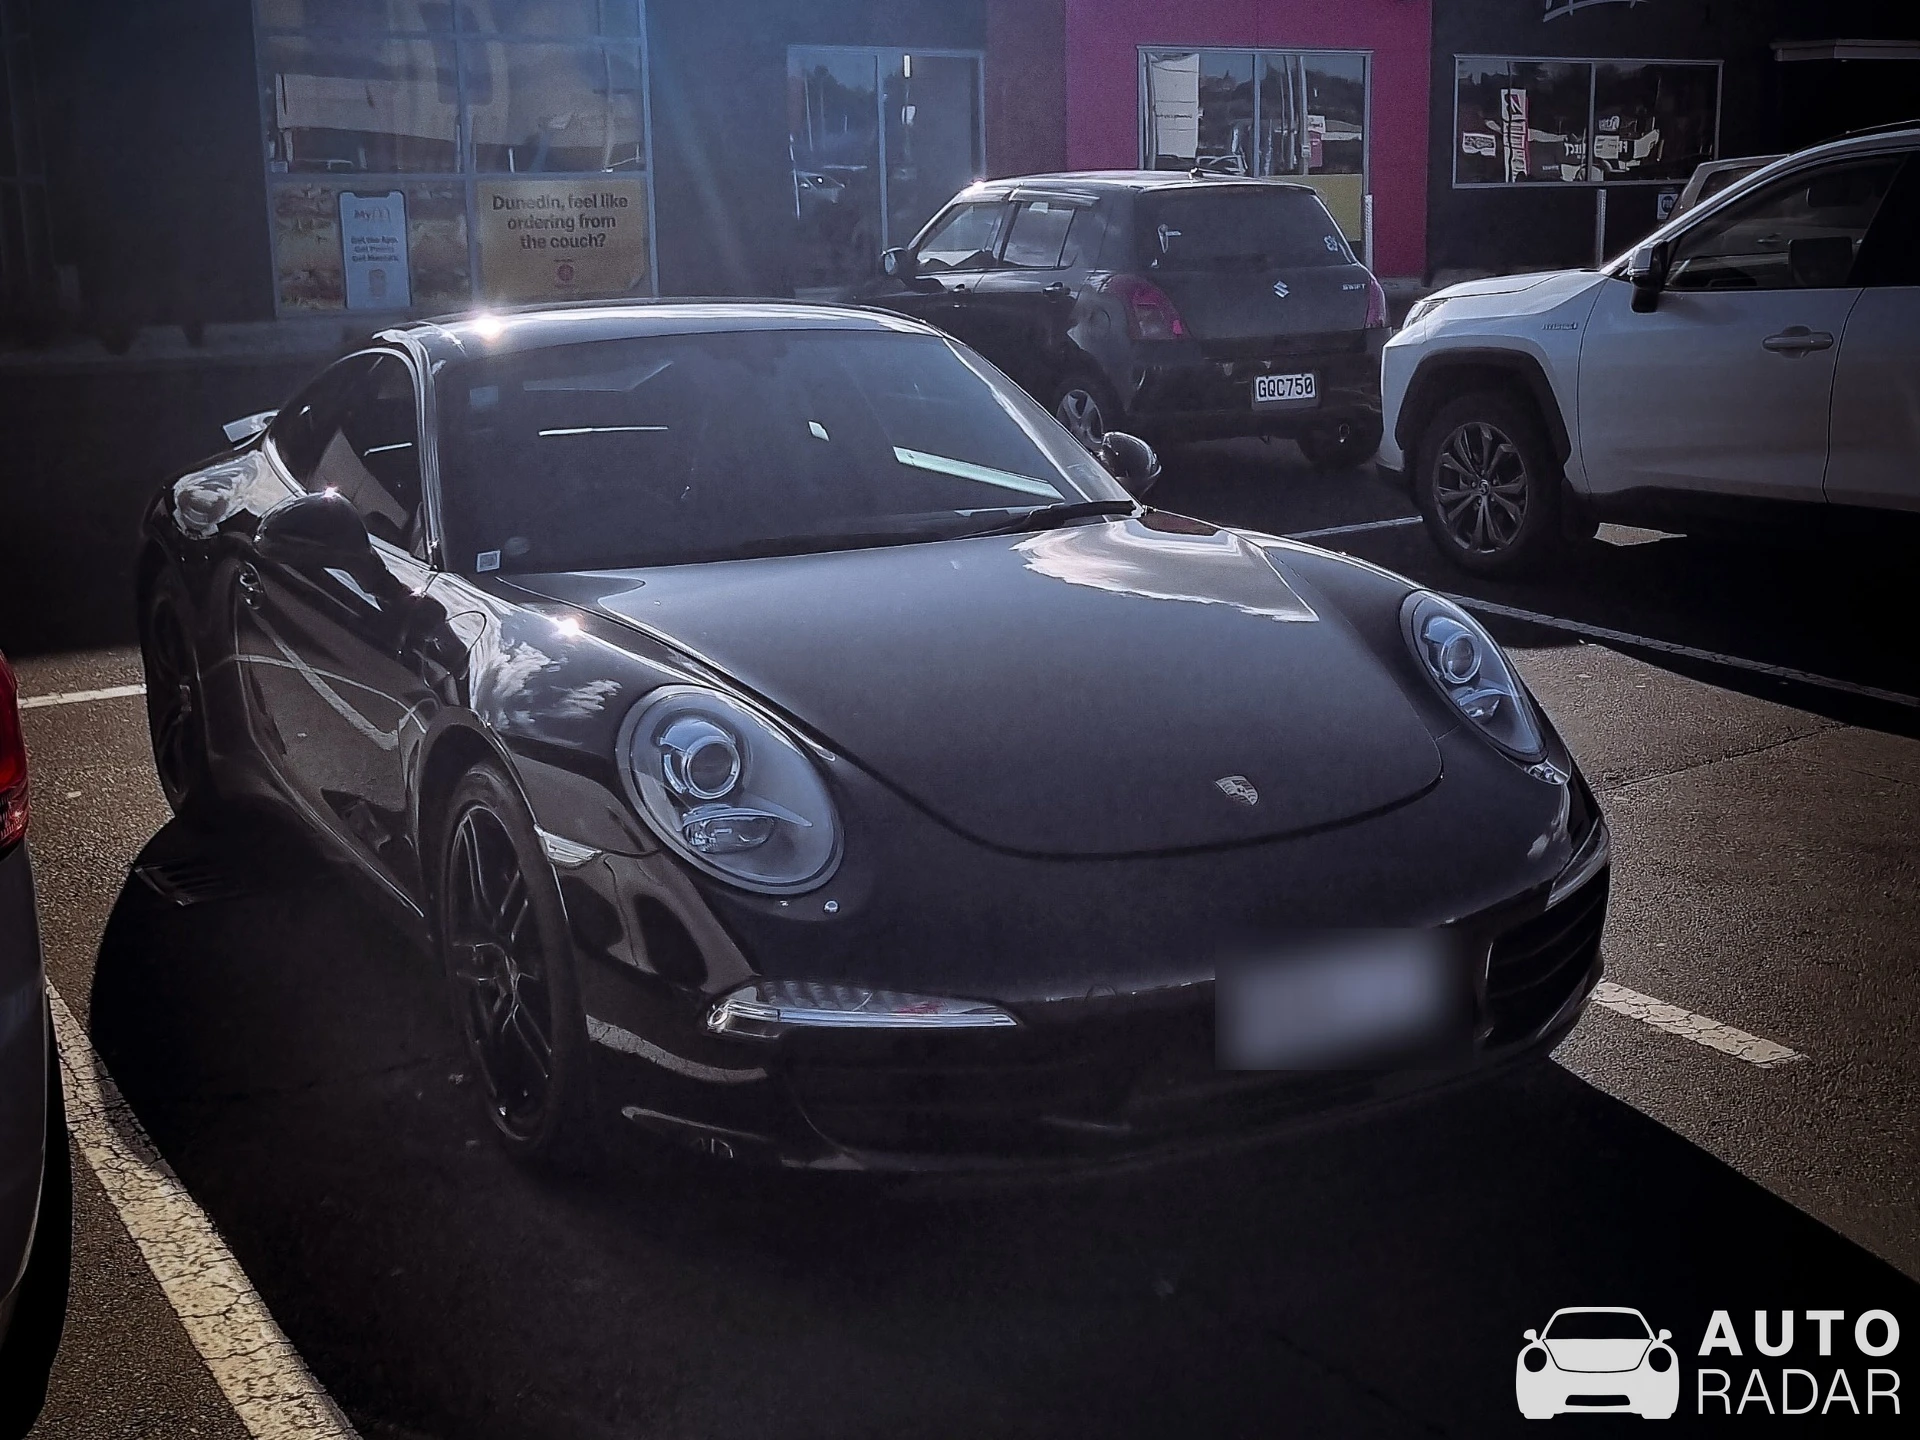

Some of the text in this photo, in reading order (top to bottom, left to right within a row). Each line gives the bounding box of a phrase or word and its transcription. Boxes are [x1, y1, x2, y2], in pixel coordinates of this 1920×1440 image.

[492, 192, 628, 211] Dunedin, feel like
[507, 213, 617, 232] ordering from
[521, 232, 607, 249] the couch?
[1342, 283, 1366, 291] SWIFT
[1258, 376, 1314, 398] GQC750
